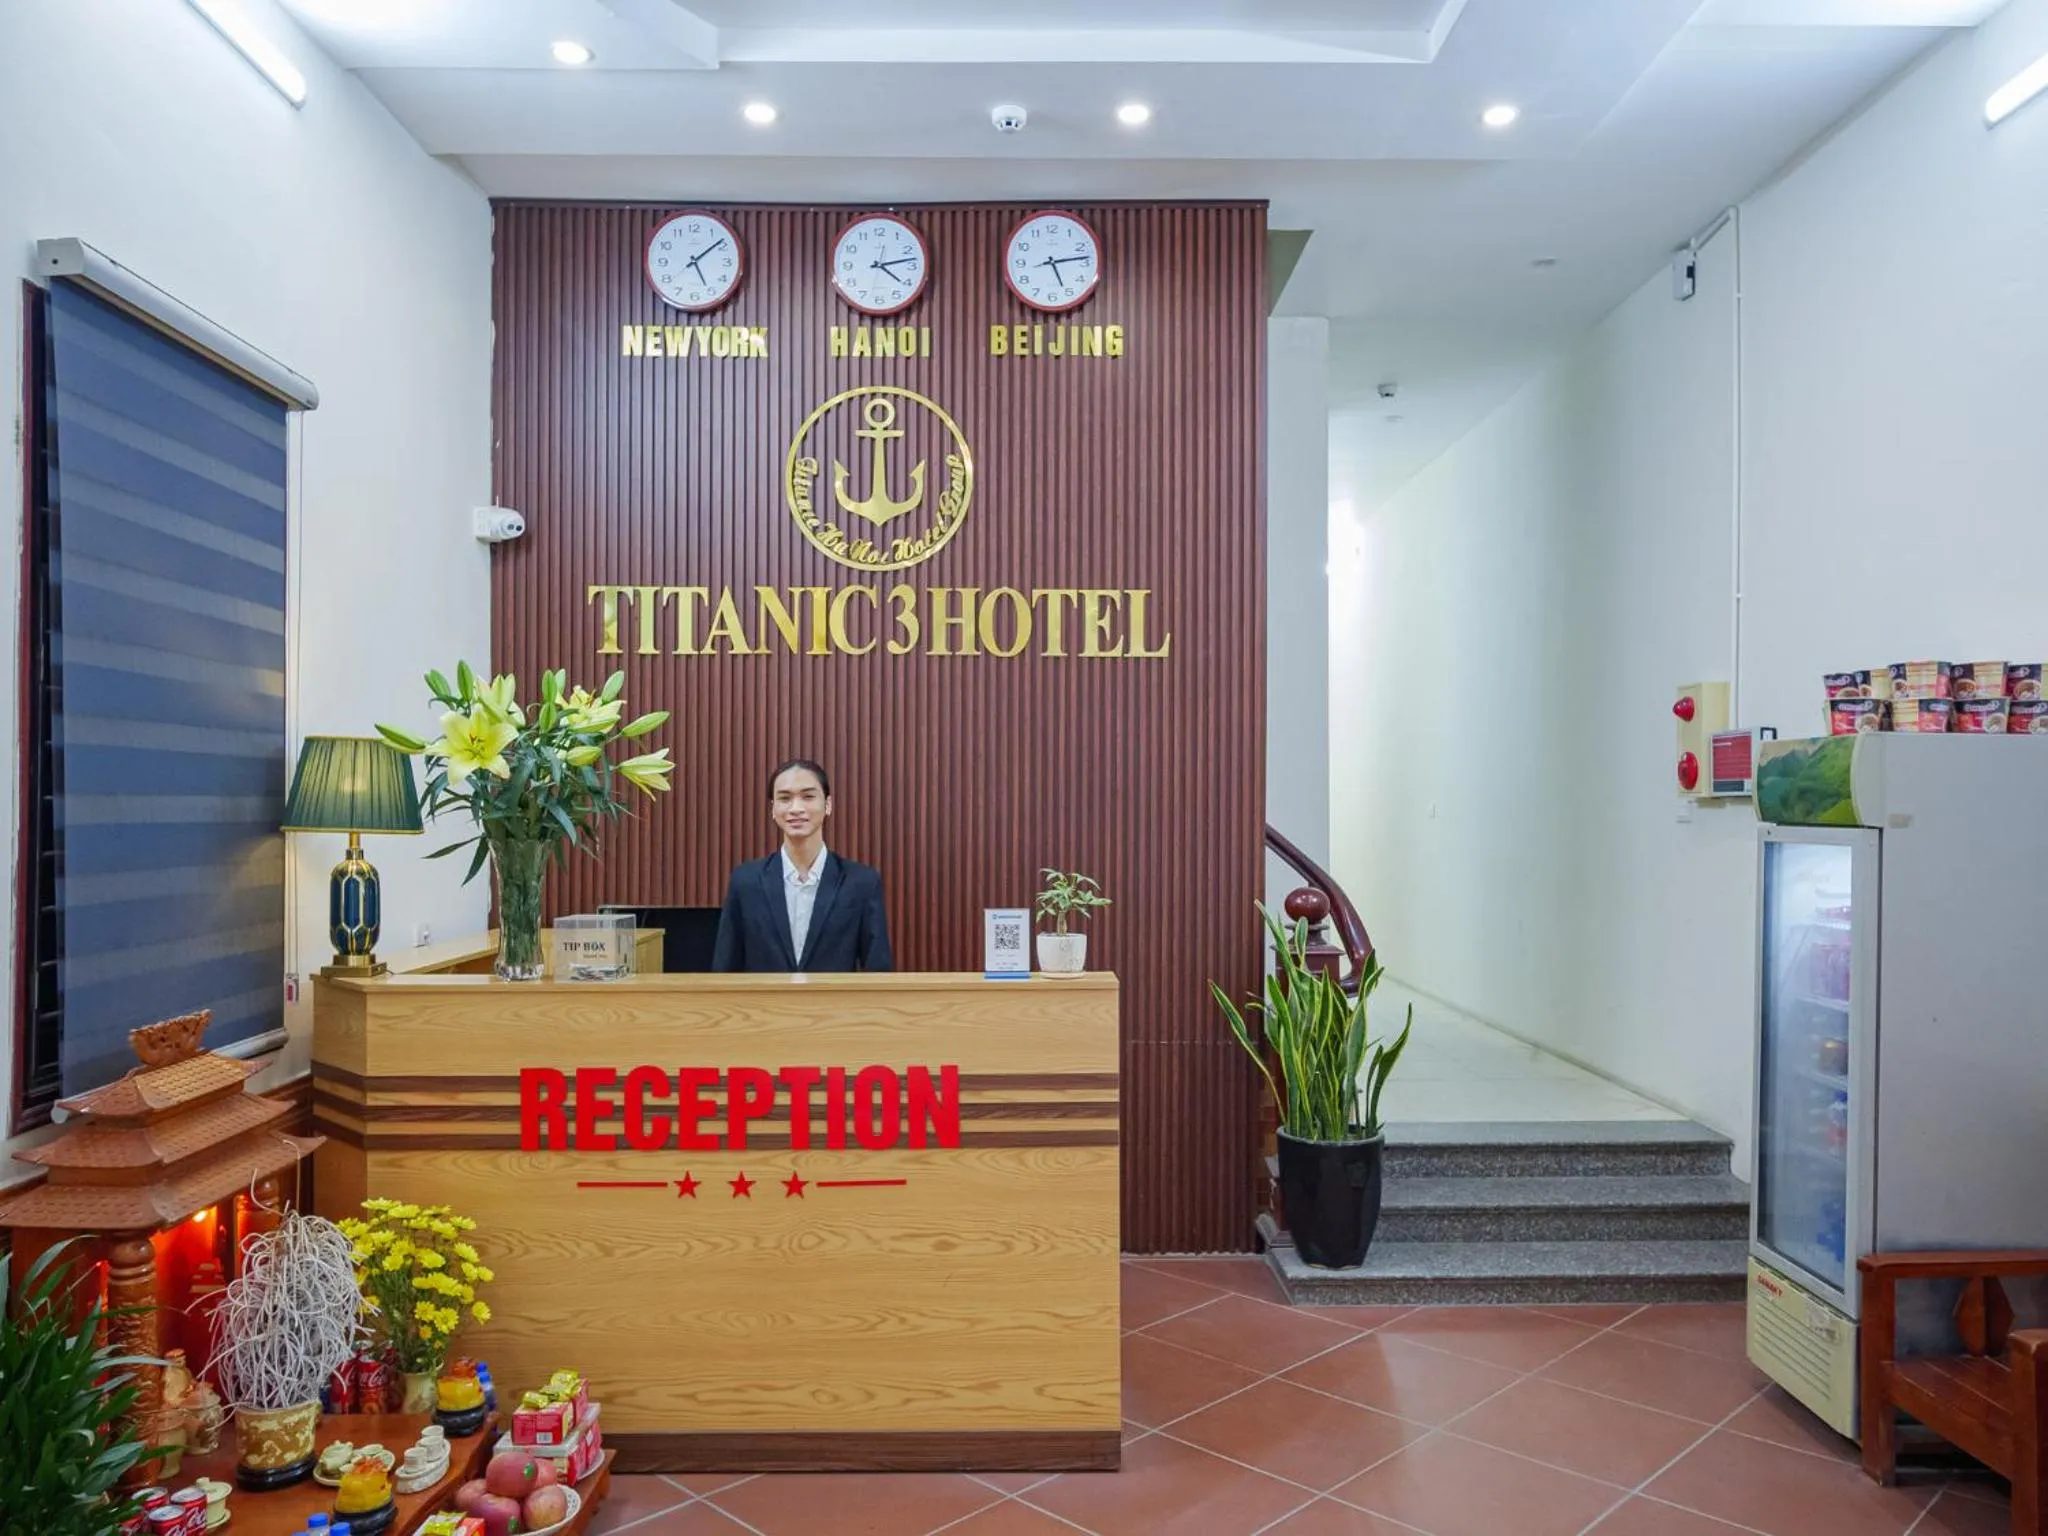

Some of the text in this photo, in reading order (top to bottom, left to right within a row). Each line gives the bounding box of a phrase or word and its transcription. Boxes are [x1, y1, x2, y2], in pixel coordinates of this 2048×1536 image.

[672, 228, 683, 238] 11
[687, 223, 701, 233] 12
[872, 226, 887, 238] 12
[1030, 228, 1041, 239] 11
[1045, 224, 1060, 235] 12
[858, 231, 869, 241] 11
[659, 240, 673, 251] 10
[718, 240, 729, 252] 2
[845, 244, 858, 255] 10
[901, 244, 914, 256] 2
[1018, 242, 1030, 253] 10
[1073, 241, 1086, 253] 2
[657, 257, 669, 268] 9
[721, 256, 733, 268] 3
[842, 260, 854, 272] 9
[906, 261, 918, 272] 3
[1015, 258, 1027, 269] 9
[1078, 257, 1091, 269] 3
[661, 273, 673, 284] 8
[717, 274, 728, 283] 4
[845, 277, 857, 289] 8
[901, 278, 913, 287] 4
[1018, 274, 1030, 285] 8
[1074, 273, 1086, 283] 4
[674, 286, 684, 297] 7
[689, 291, 701, 302] 6
[706, 286, 717, 297] 5
[856, 289, 869, 300] 7
[891, 289, 903, 301] 5
[1031, 287, 1041, 298] 7
[1064, 287, 1075, 298] 5
[873, 295, 886, 306] 6
[1047, 292, 1059, 303] 6
[830, 326, 930, 357] HANOI
[991, 325, 1124, 357] BEIJING
[816, 521, 849, 554] Ha
[850, 539, 889, 564] Noi
[892, 511, 951, 561] Hotel
[562, 941, 606, 951] TIP BOX
[519, 1065, 961, 1152] RECEPTION
